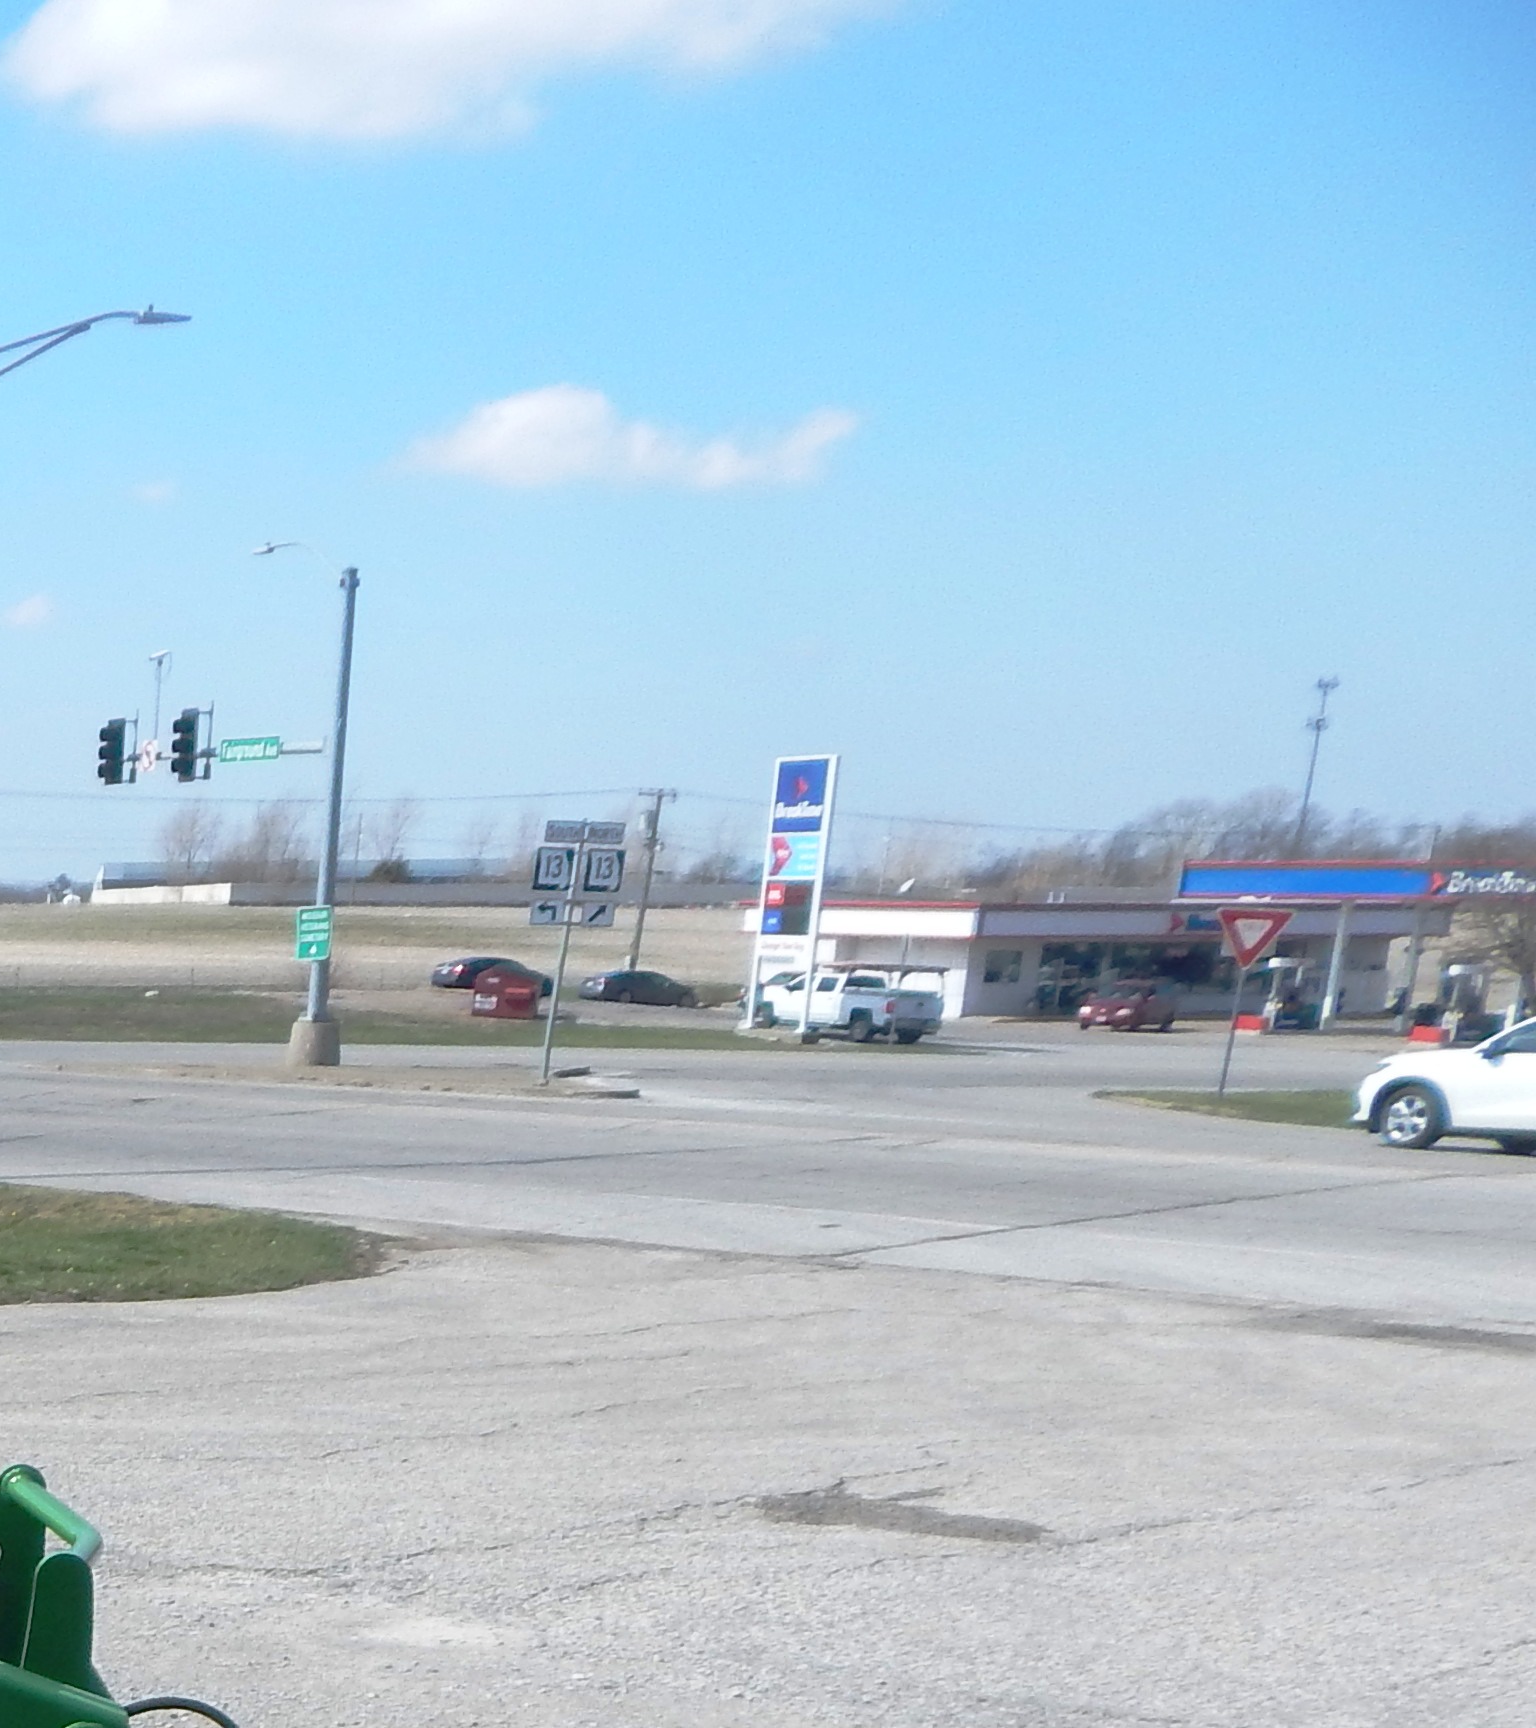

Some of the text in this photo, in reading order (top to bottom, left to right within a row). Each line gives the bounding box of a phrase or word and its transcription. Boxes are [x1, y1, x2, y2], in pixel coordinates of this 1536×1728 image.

[222, 741, 265, 761] Fairground
[544, 854, 564, 879] 13
[595, 855, 615, 880] 13
